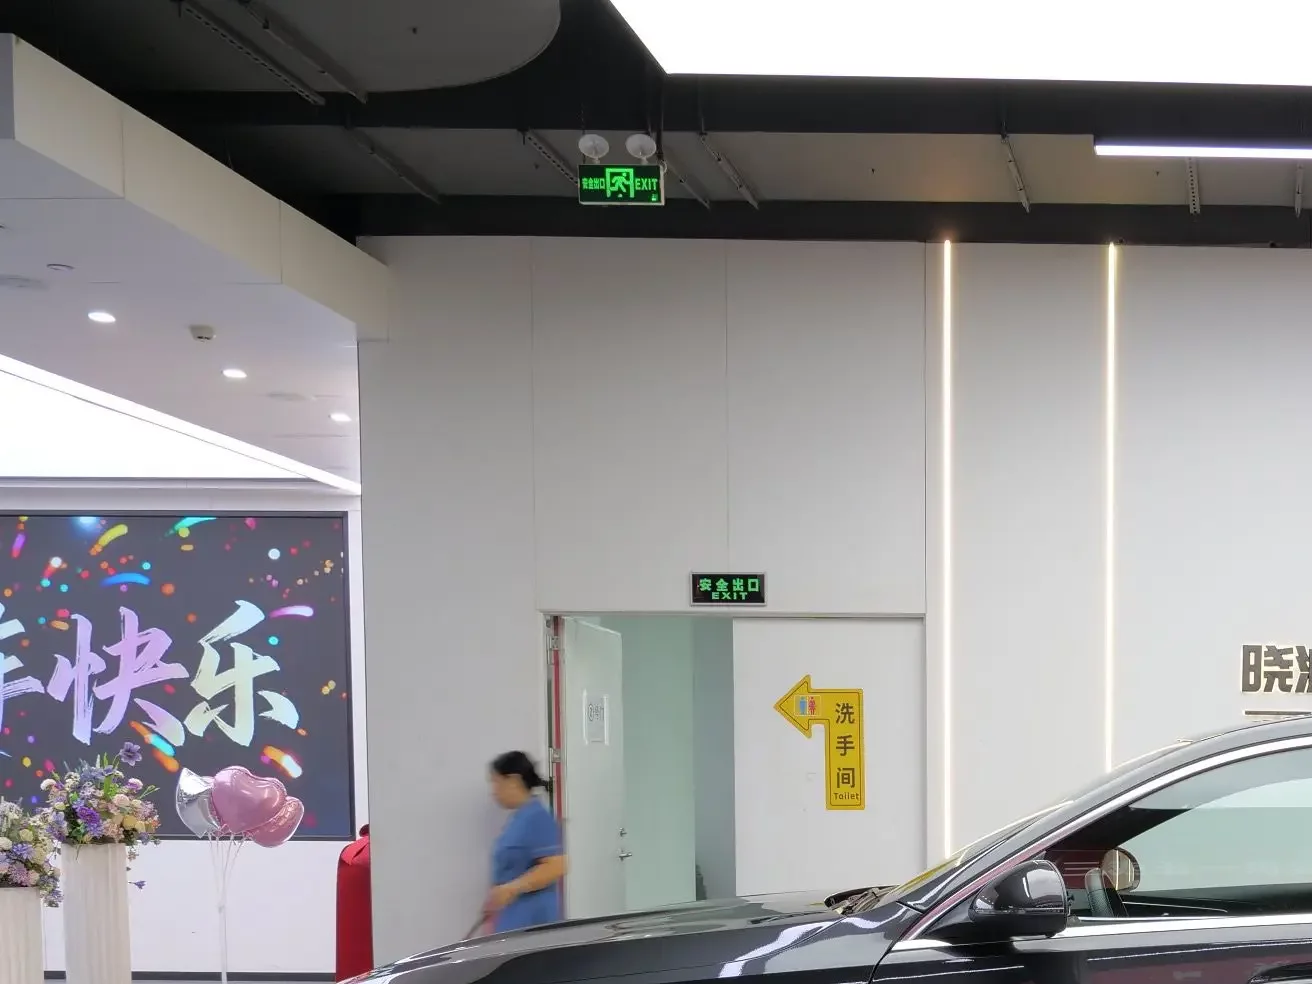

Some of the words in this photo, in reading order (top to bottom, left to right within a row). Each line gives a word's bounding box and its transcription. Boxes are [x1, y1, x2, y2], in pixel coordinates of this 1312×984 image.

[635, 178, 658, 191] EXIT
[699, 578, 760, 592] 安全出口
[711, 591, 748, 600] EXIT
[835, 702, 856, 789] 洗手间
[833, 792, 860, 800] Toilet
